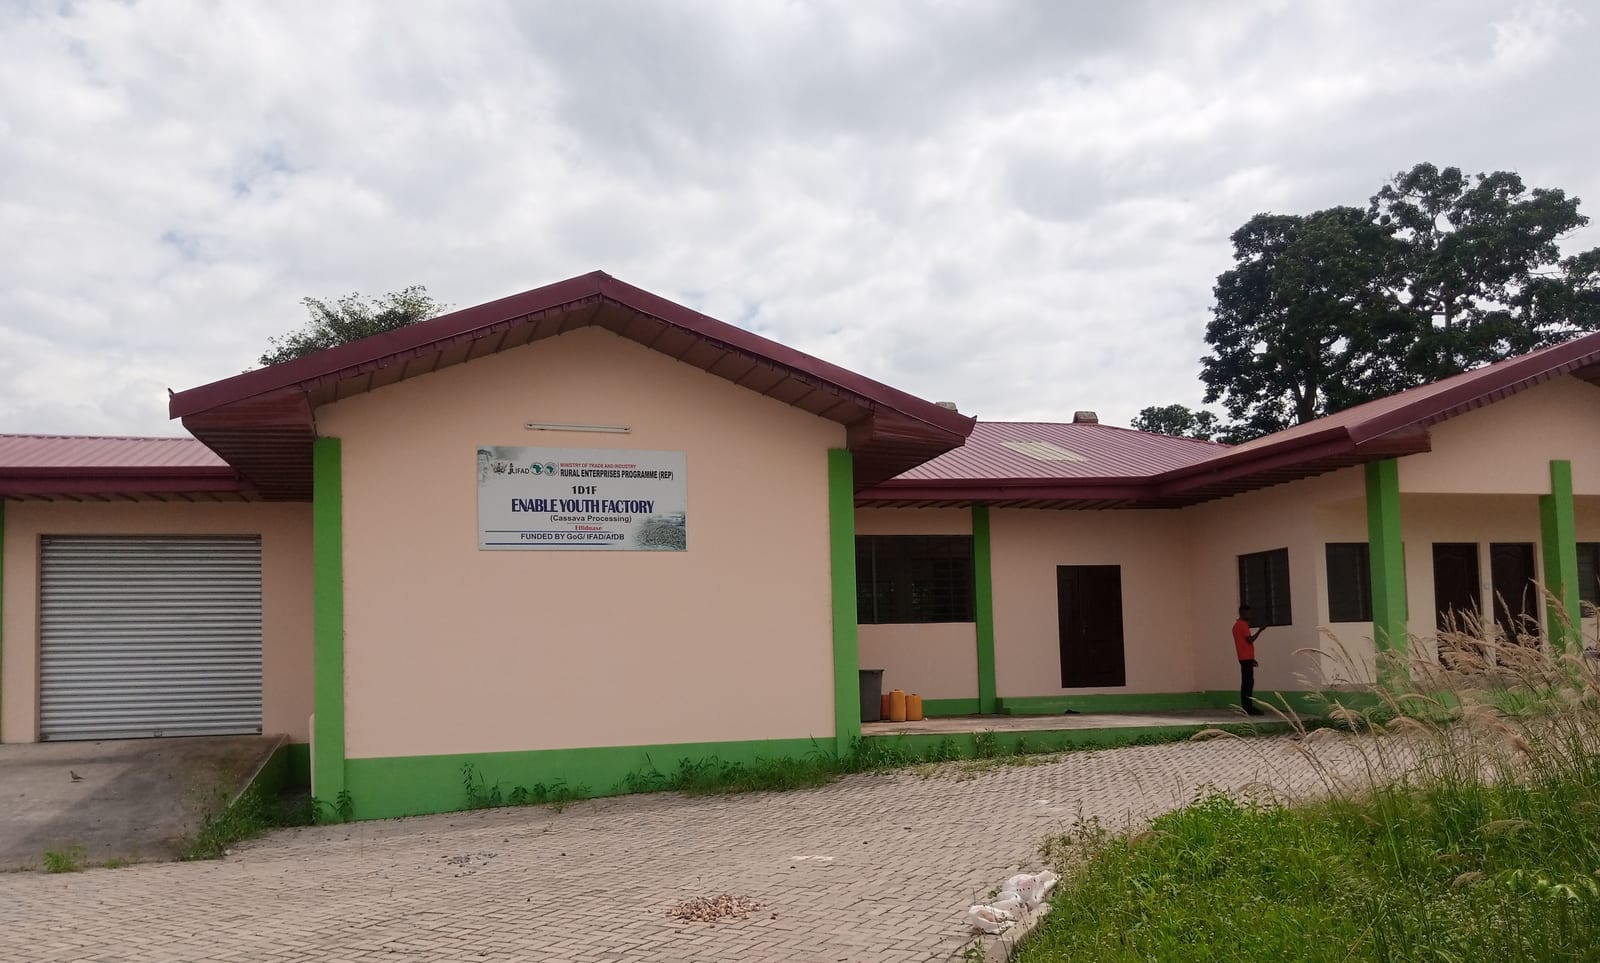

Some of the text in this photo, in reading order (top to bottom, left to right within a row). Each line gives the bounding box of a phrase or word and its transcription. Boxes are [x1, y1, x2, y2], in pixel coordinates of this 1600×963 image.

[560, 469, 674, 480] RURAL ENTERPRISES PROGRAMME (REP)
[572, 486, 598, 494] 1D1F
[512, 498, 654, 514] ENABLE YOUTH FACTORY
[587, 515, 632, 523] Processing)
